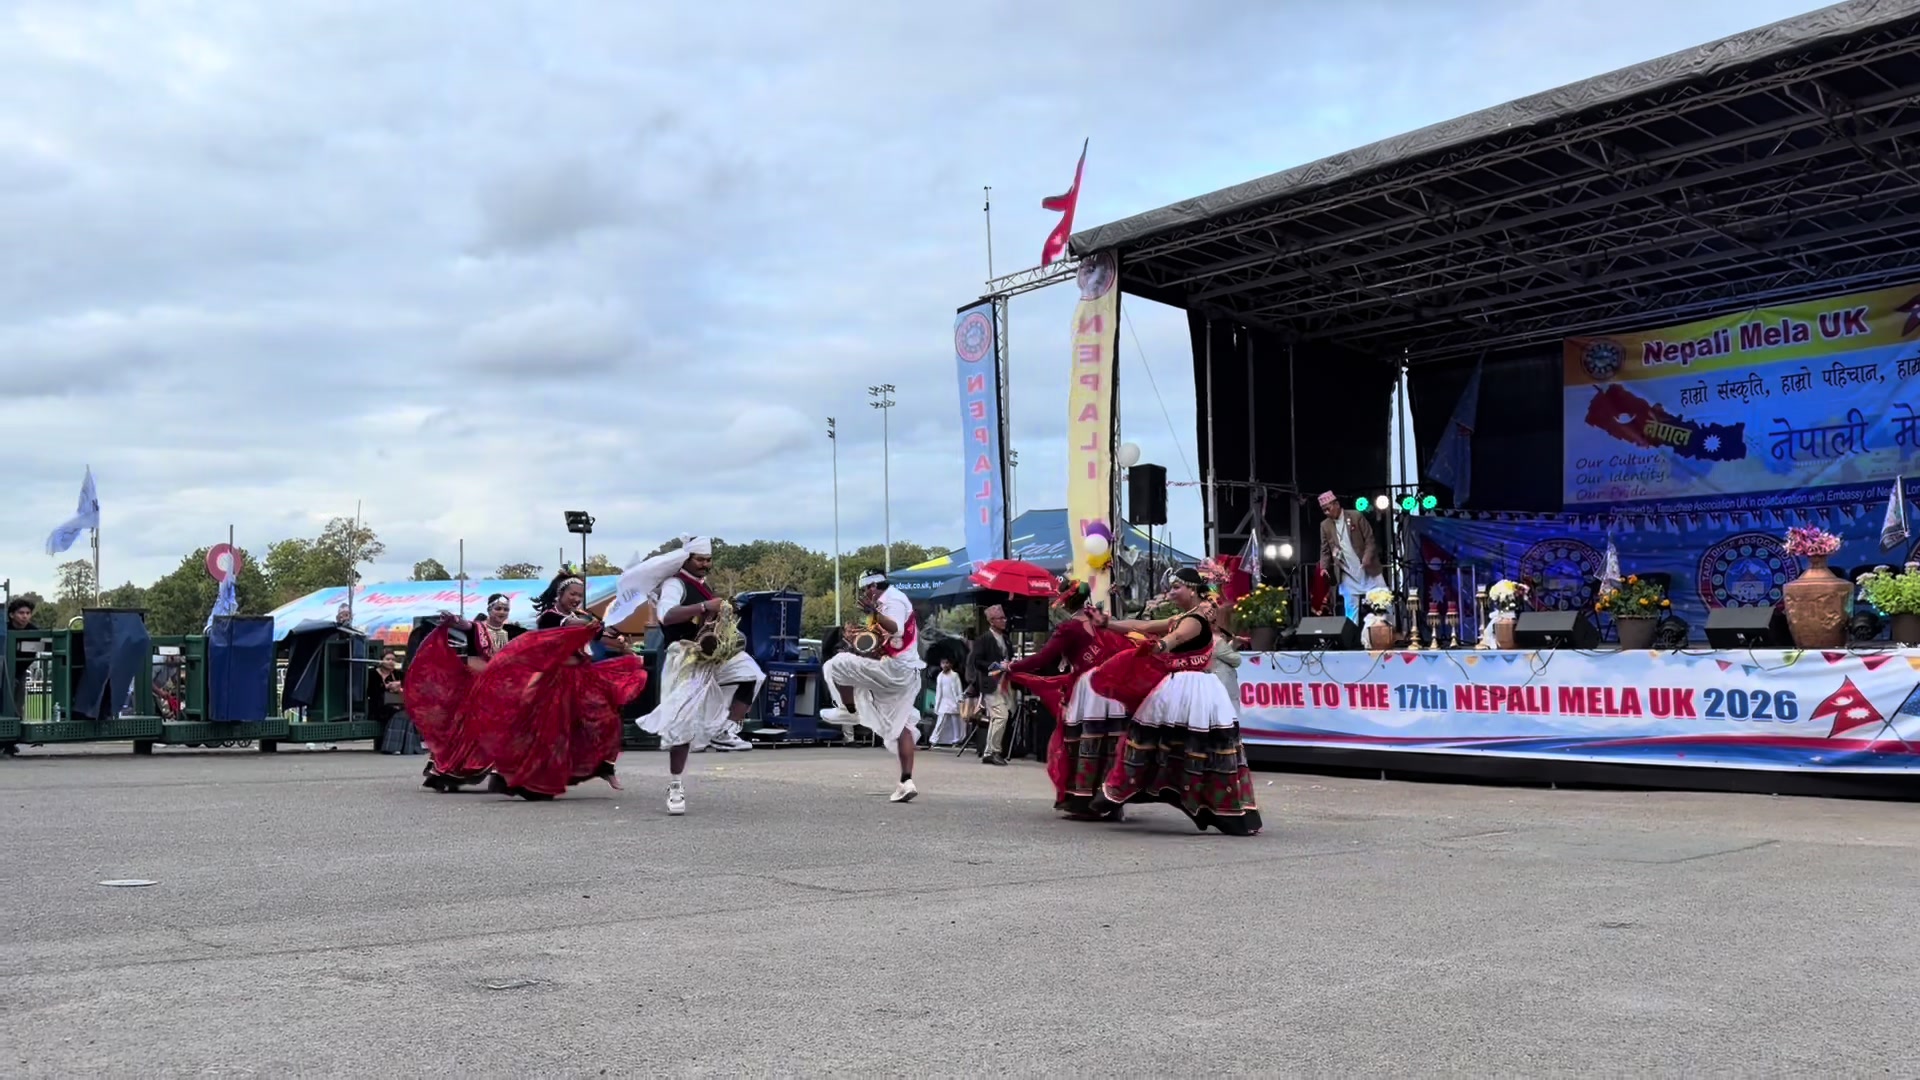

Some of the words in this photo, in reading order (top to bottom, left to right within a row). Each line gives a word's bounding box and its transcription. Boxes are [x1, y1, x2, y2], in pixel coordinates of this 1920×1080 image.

[1642, 327, 1732, 367] Nepali
[1739, 318, 1811, 352] Mela
[1818, 305, 1870, 340] UK
[1680, 379, 1709, 408] हाम्रो
[1781, 366, 1813, 396] हाम्रो
[1768, 407, 1870, 462] नेपाली
[1575, 457, 1605, 470] Our
[1575, 473, 1602, 486] Our
[1827, 489, 1865, 502] Embassy
[1240, 682, 1303, 708] COME
[1308, 682, 1341, 709] TO
[1344, 683, 1390, 710] THE
[1394, 683, 1448, 711] 17th
[1455, 683, 1551, 713] NEPALI
[1558, 686, 1642, 717] MELA
[1649, 687, 1697, 719] UK
[1703, 688, 1799, 722] 2026
